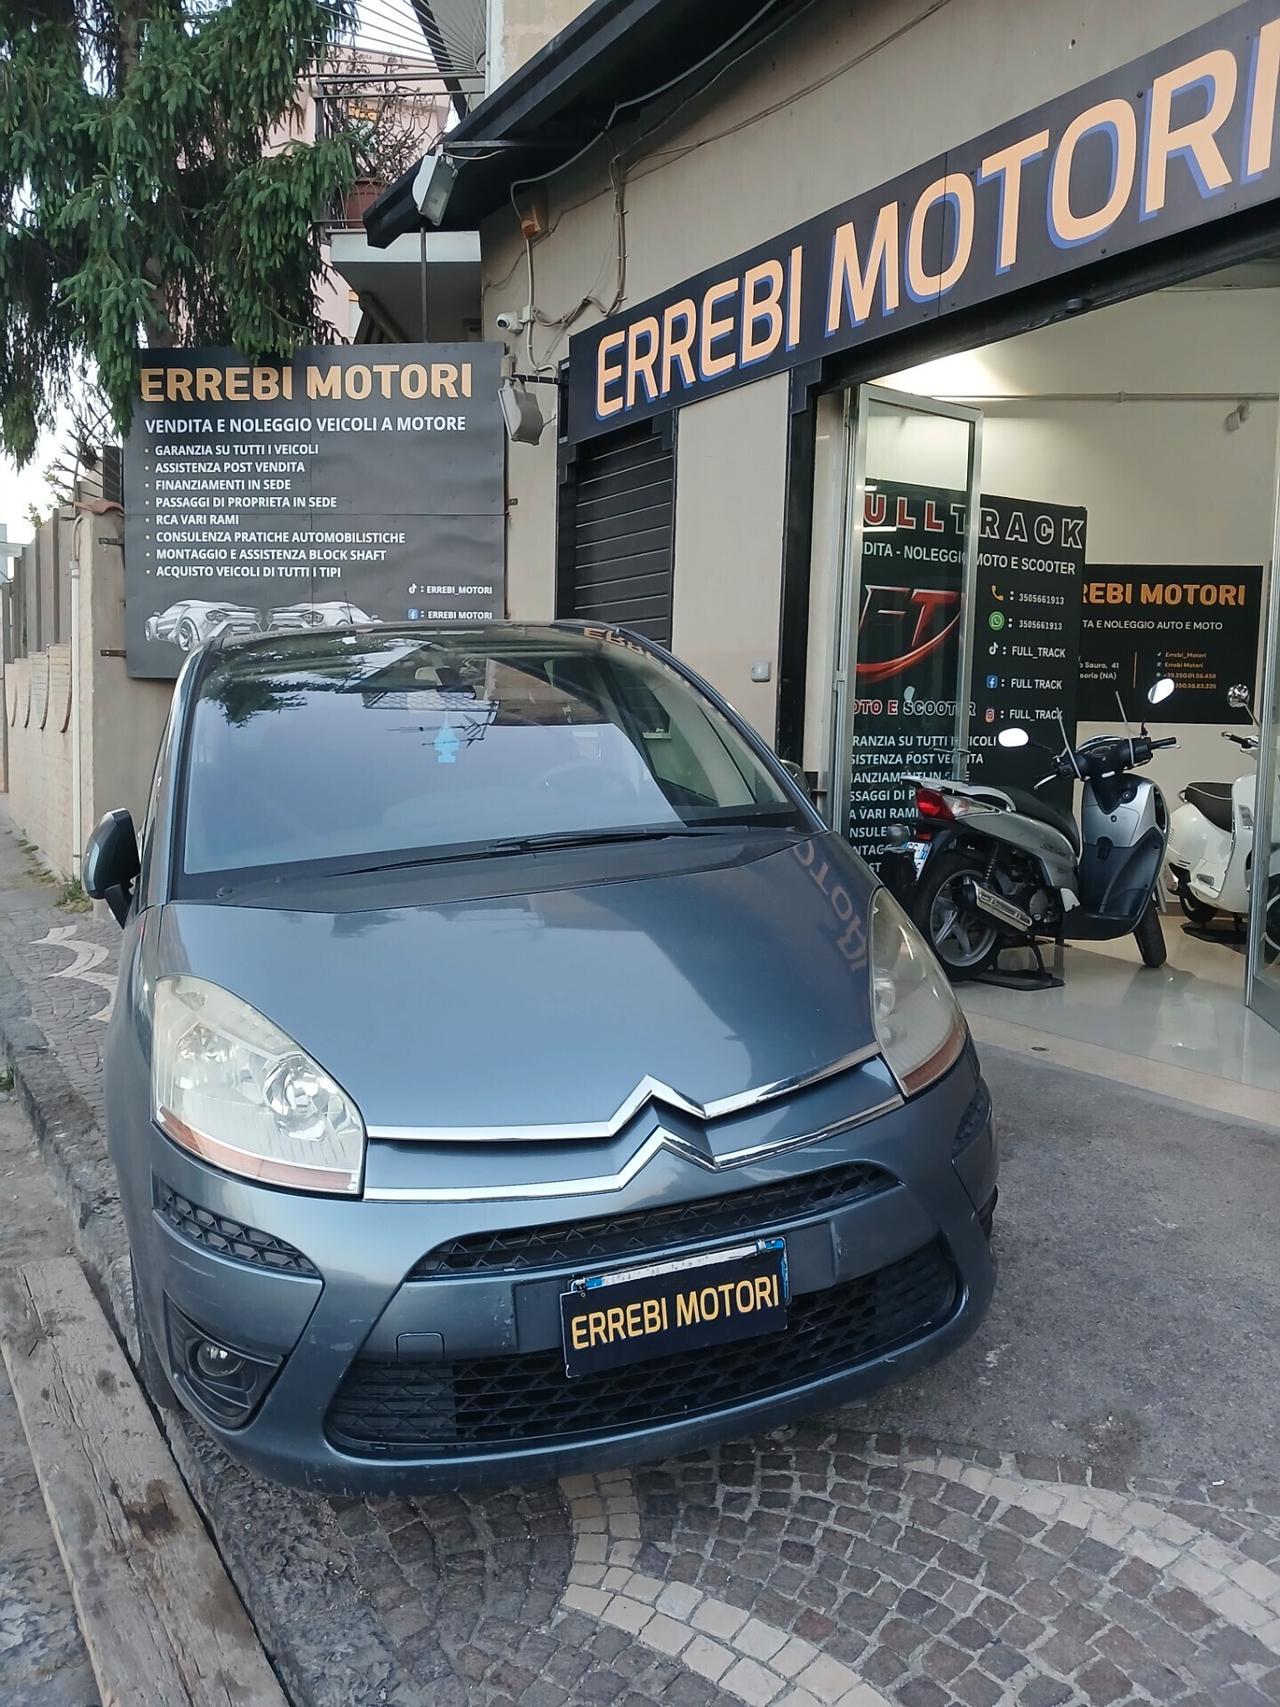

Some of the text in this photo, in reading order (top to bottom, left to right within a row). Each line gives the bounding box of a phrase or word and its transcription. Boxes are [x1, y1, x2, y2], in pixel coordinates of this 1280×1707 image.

[594, 18, 1280, 421] ERREBI MOTORI
[140, 363, 472, 402] ERREBI MOTORI
[145, 416, 467, 434] VENDITA E NOLEGGIO VEICOLI A MOTORE
[155, 445, 319, 456] GARANZIA SU TUTTI I VEICOLI
[155, 462, 305, 473] ASSISTENZA POST VENDITA
[155, 480, 291, 491] FINANZIAMENTI IN SEDE
[155, 497, 337, 509] PASSAGGI DI PROPRIETA IN SEDE
[156, 514, 239, 525] RCA VARI RAMI
[863, 493, 1085, 549] ULLTRACK
[156, 532, 405, 543] CONSULENZA PRATICHE AUTOMOBILISTICHE
[156, 549, 386, 560] MONTAGGIO E ASSISTENZA BLOCK SHAFT
[863, 541, 894, 558] DITA
[1011, 557, 1019, 570] E
[1021, 558, 1076, 575] SCOOTER
[156, 566, 341, 578] ACQUISTO VEICOLI DI TUTTI I TIPI
[426, 585, 493, 596] ERREBI_MOTORI
[1140, 584, 1246, 606] MOTORI
[1018, 592, 1065, 606] 3505661913
[428, 611, 492, 620] ERREBI MOTORI
[1096, 620, 1102, 628] E
[1104, 620, 1155, 630] NOLEGGIO
[1157, 621, 1184, 630] AUTO
[1186, 622, 1191, 630] E
[1193, 622, 1224, 630] MOTO
[1012, 646, 1066, 660] FULL_TRACK
[1011, 678, 1062, 691] FULL TRACK
[852, 699, 976, 716] OTO E SCOOTR
[1009, 709, 1063, 722] FULL_TRACK
[852, 736, 896, 747] RANZIA
[898, 736, 913, 747] SU
[916, 736, 948, 746] TUTTI
[850, 754, 903, 765] SISTENZA
[906, 754, 936, 764] POST
[850, 790, 890, 802] SSAGGI
[894, 790, 906, 801] DI
[860, 808, 886, 820] VARI
[890, 808, 918, 819] RAMI
[571, 1274, 780, 1350] ERREBI MOTORI
